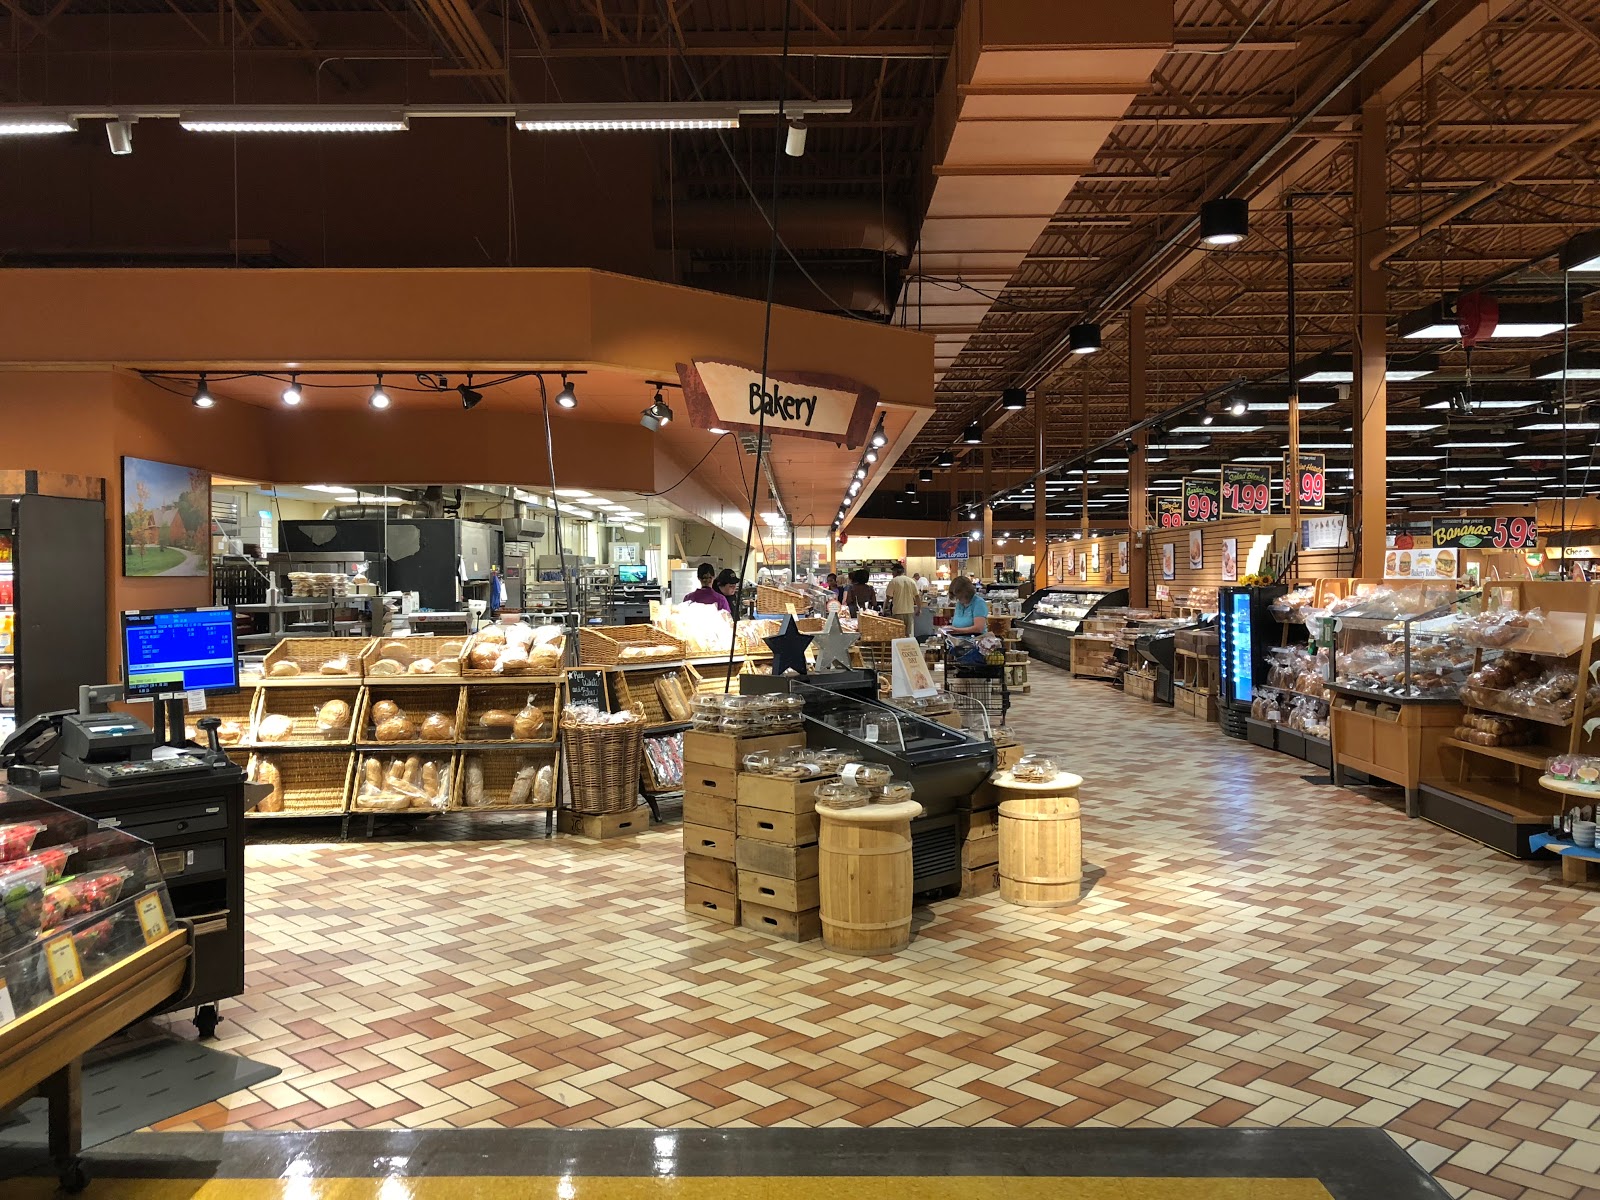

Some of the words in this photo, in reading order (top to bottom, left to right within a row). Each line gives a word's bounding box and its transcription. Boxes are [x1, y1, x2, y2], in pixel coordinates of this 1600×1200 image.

[749, 383, 817, 426] Bakery
[1223, 482, 1269, 511] $1.99
[1284, 473, 1324, 502] $.99
[1433, 525, 1492, 546] Bananas
